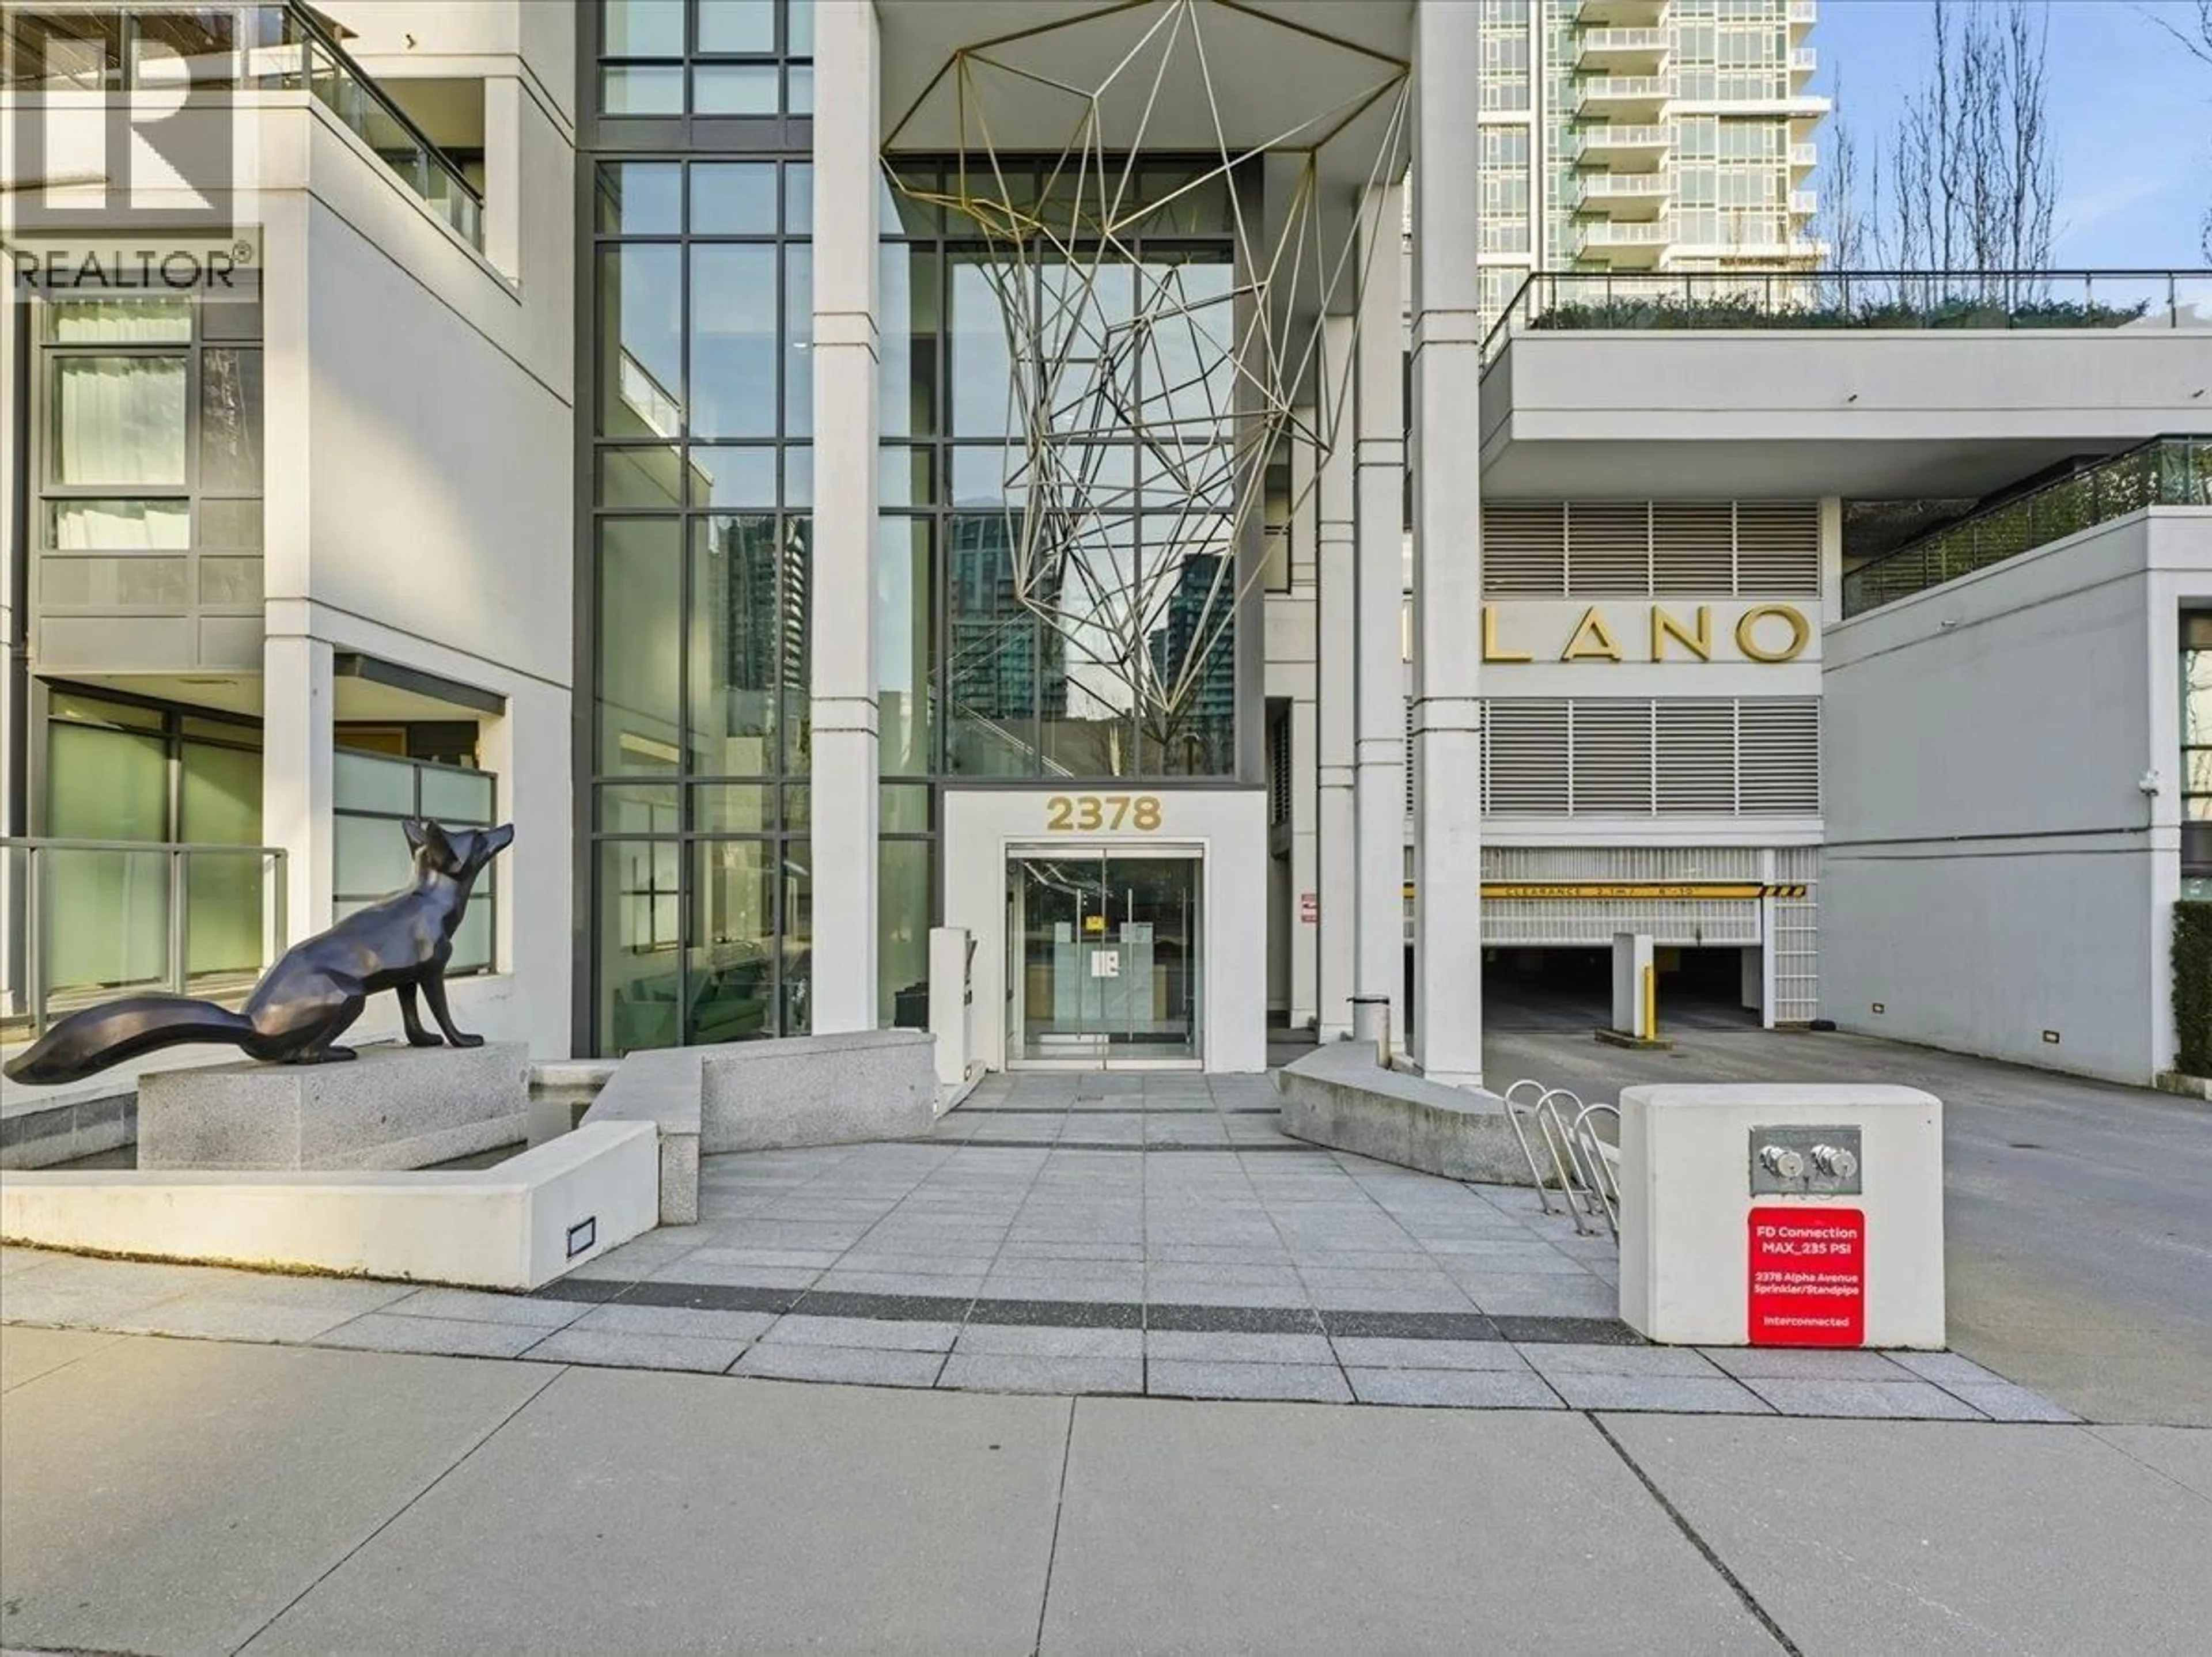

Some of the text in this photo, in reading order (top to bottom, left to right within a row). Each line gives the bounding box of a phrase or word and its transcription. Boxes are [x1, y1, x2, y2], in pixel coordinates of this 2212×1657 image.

[1482, 604, 1810, 663] LANO
[1047, 795, 1161, 831] 2378
[1505, 887, 1580, 897] CLEARANCE
[1757, 1226, 1857, 1239] FD Connection
[1830, 1243, 1851, 1254] PSI
[1755, 1272, 1858, 1283] 2378 Alpha Avenue
[1755, 1284, 1859, 1295] Sprinkler/Standpipe
[1764, 1315, 1850, 1327] Interconnected
